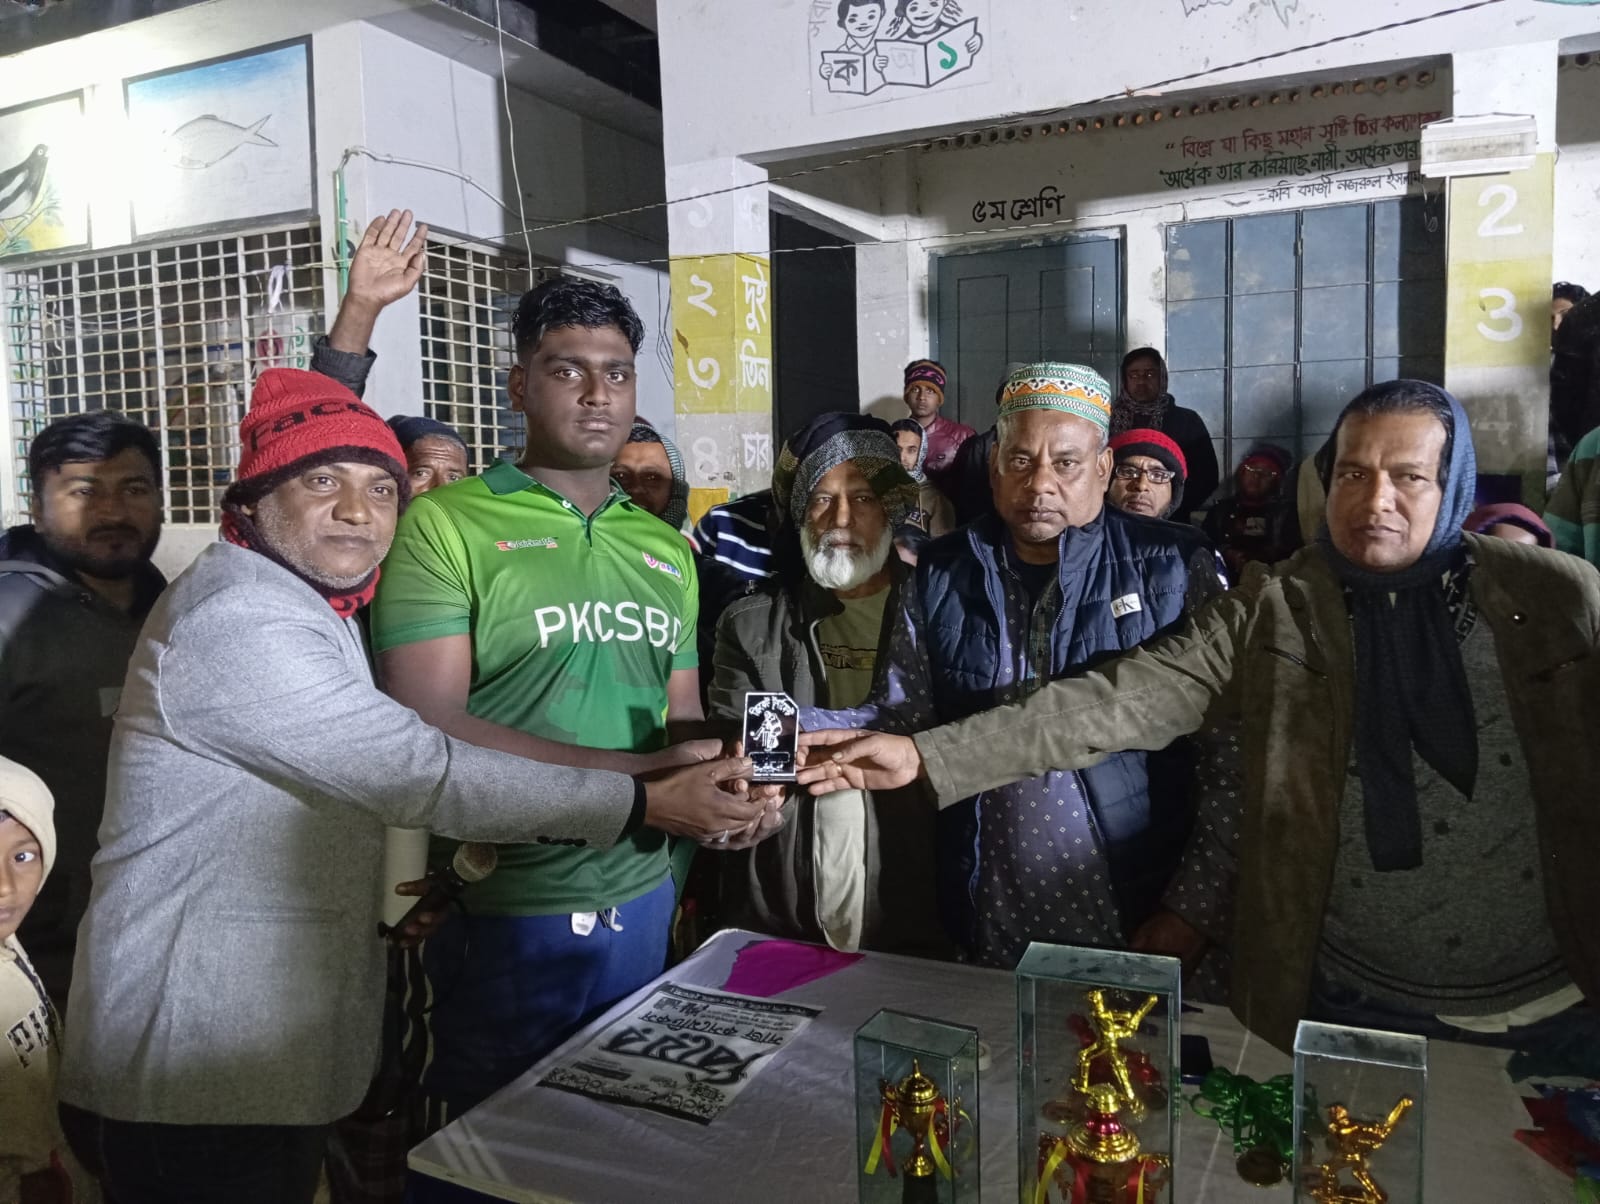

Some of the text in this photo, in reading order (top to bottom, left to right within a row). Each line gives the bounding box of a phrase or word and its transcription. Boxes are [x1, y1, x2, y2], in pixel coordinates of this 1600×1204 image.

[833, 59, 860, 86] ক
[938, 41, 958, 69] ১
[1220, 138, 1237, 153] যা
[1242, 128, 1273, 153] কিছু
[1277, 126, 1314, 149] মহান
[1354, 112, 1381, 136] চির
[1216, 162, 1246, 181] তার
[1249, 150, 1312, 176] করিয়াছে
[1393, 140, 1421, 161] তার
[972, 186, 1066, 223] ৫ম শ্রেণি
[1297, 174, 1333, 198] কাজী
[1336, 175, 1382, 194] নজরুল
[688, 187, 713, 228] ১
[1477, 184, 1524, 237] 2
[688, 274, 718, 317] ২
[742, 263, 768, 334] দুই
[1477, 287, 1523, 342] 3
[687, 357, 720, 390] ৩
[739, 339, 769, 392] তিন
[692, 436, 719, 480] ৪
[741, 432, 769, 471] চার
